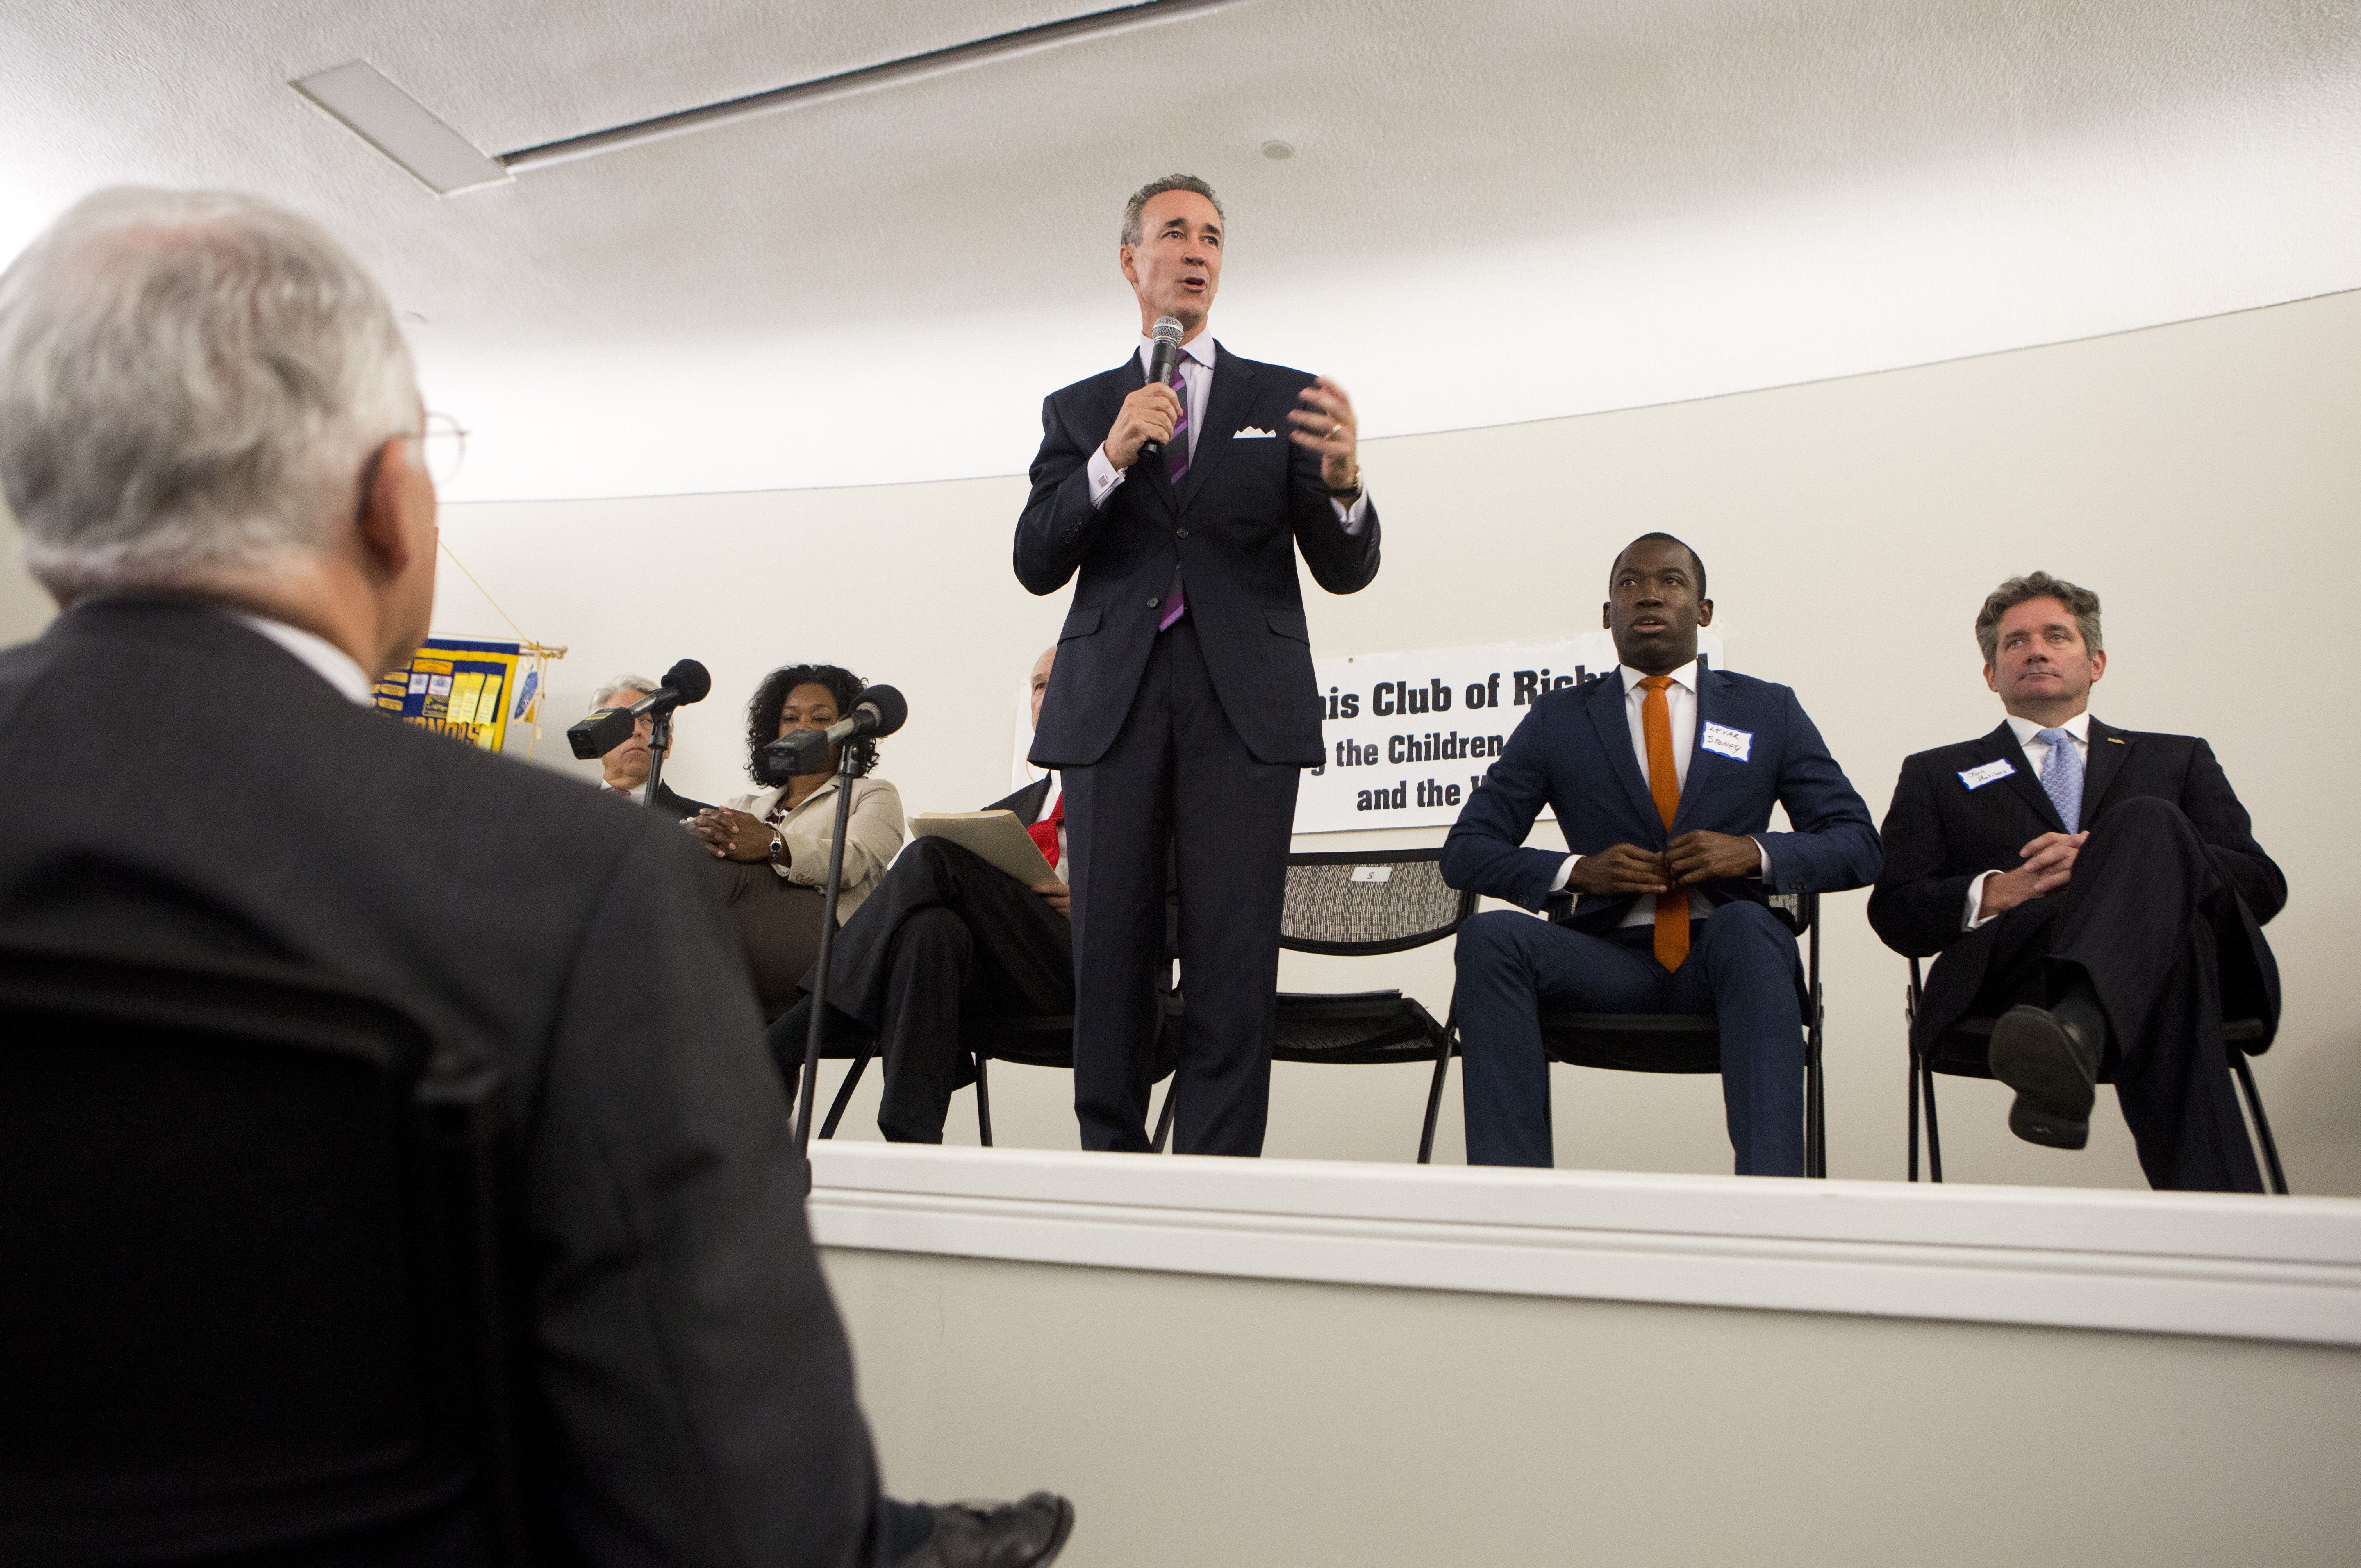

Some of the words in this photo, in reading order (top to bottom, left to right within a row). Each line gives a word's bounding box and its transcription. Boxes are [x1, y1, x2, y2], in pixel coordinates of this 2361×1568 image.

[1373, 678, 1451, 716] Club
[1465, 673, 1500, 709] of
[1336, 738, 1378, 767] the
[1388, 731, 1503, 764] Children
[1708, 736, 1741, 754] STONEY
[1357, 780, 1407, 811] and
[1417, 778, 1460, 807] the
